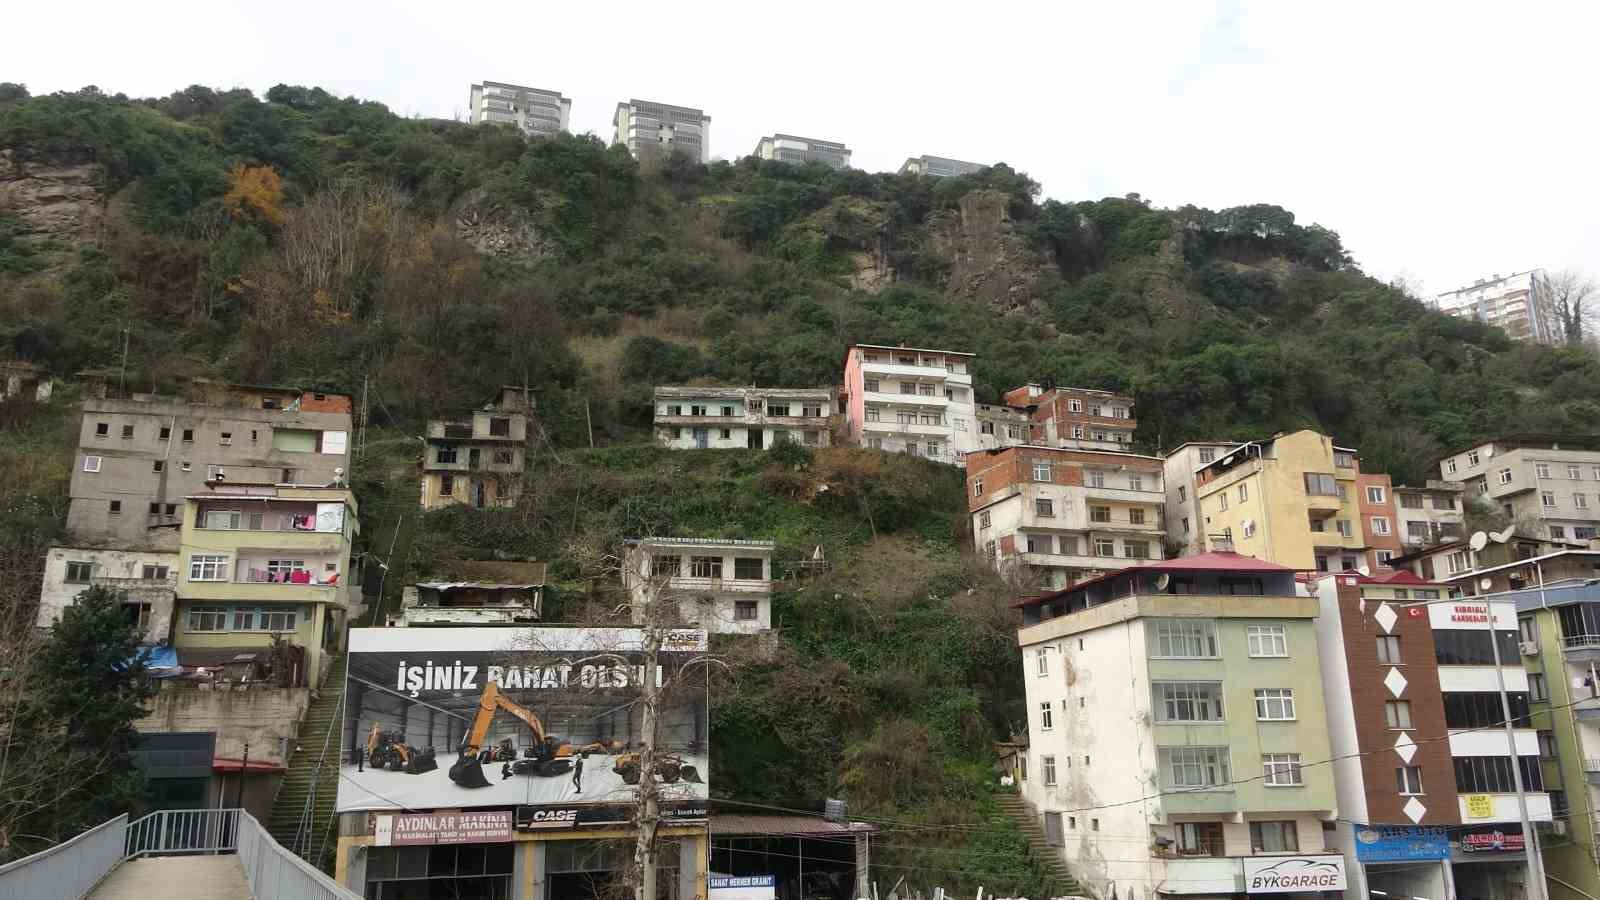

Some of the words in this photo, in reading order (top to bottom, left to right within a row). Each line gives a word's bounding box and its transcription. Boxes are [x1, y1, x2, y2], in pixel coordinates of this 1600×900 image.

[397, 660, 478, 698] İŞİNİZ
[580, 664, 663, 689] OLSU
[396, 817, 456, 832] AYDINLAR
[458, 814, 508, 829] MAKİNA
[533, 810, 578, 822] CASE
[1252, 874, 1338, 889] BYKGARAGE
